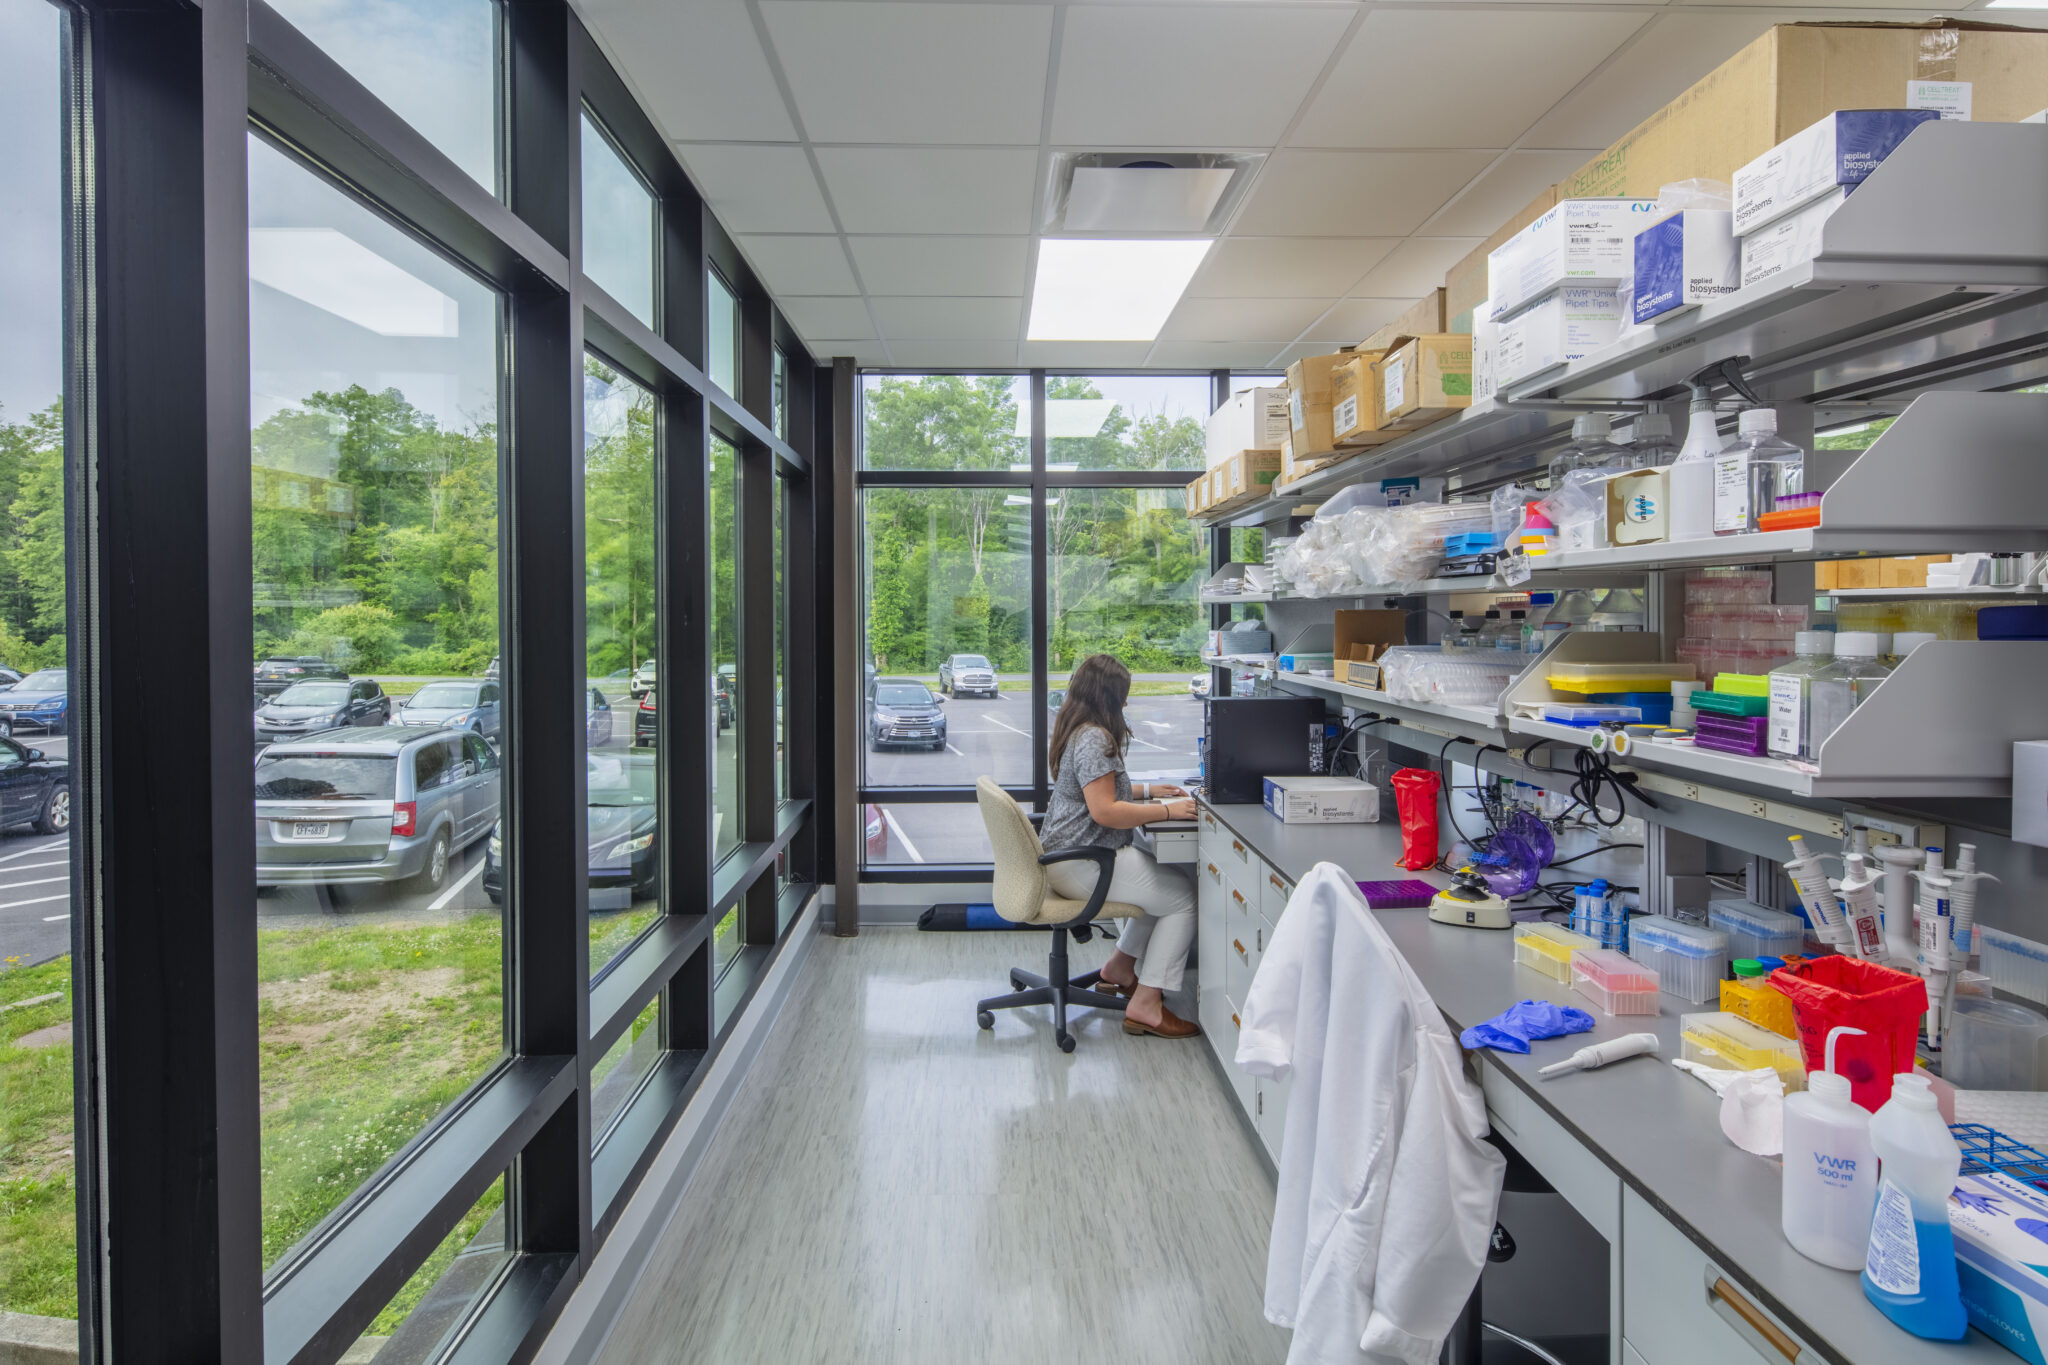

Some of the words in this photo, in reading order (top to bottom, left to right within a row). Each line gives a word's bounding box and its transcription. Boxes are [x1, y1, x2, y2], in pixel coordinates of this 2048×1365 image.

[1844, 152, 1871, 161] applied
[1573, 144, 1628, 197] CELLTREAT
[1736, 199, 1753, 214] applied
[1736, 197, 1773, 223] biosystems
[1744, 264, 1782, 286] biosystems
[1566, 299, 1589, 310] Pipet
[1592, 299, 1609, 309] Tips
[1636, 291, 1673, 312] biosystems
[1779, 706, 1792, 714] Water
[1813, 1151, 1857, 1171] VWR
[1817, 1167, 1839, 1179] 500
[1841, 1173, 1853, 1182] ml
[1988, 1174, 2028, 1197] VWR
[1989, 1313, 2027, 1343] GLOVES
